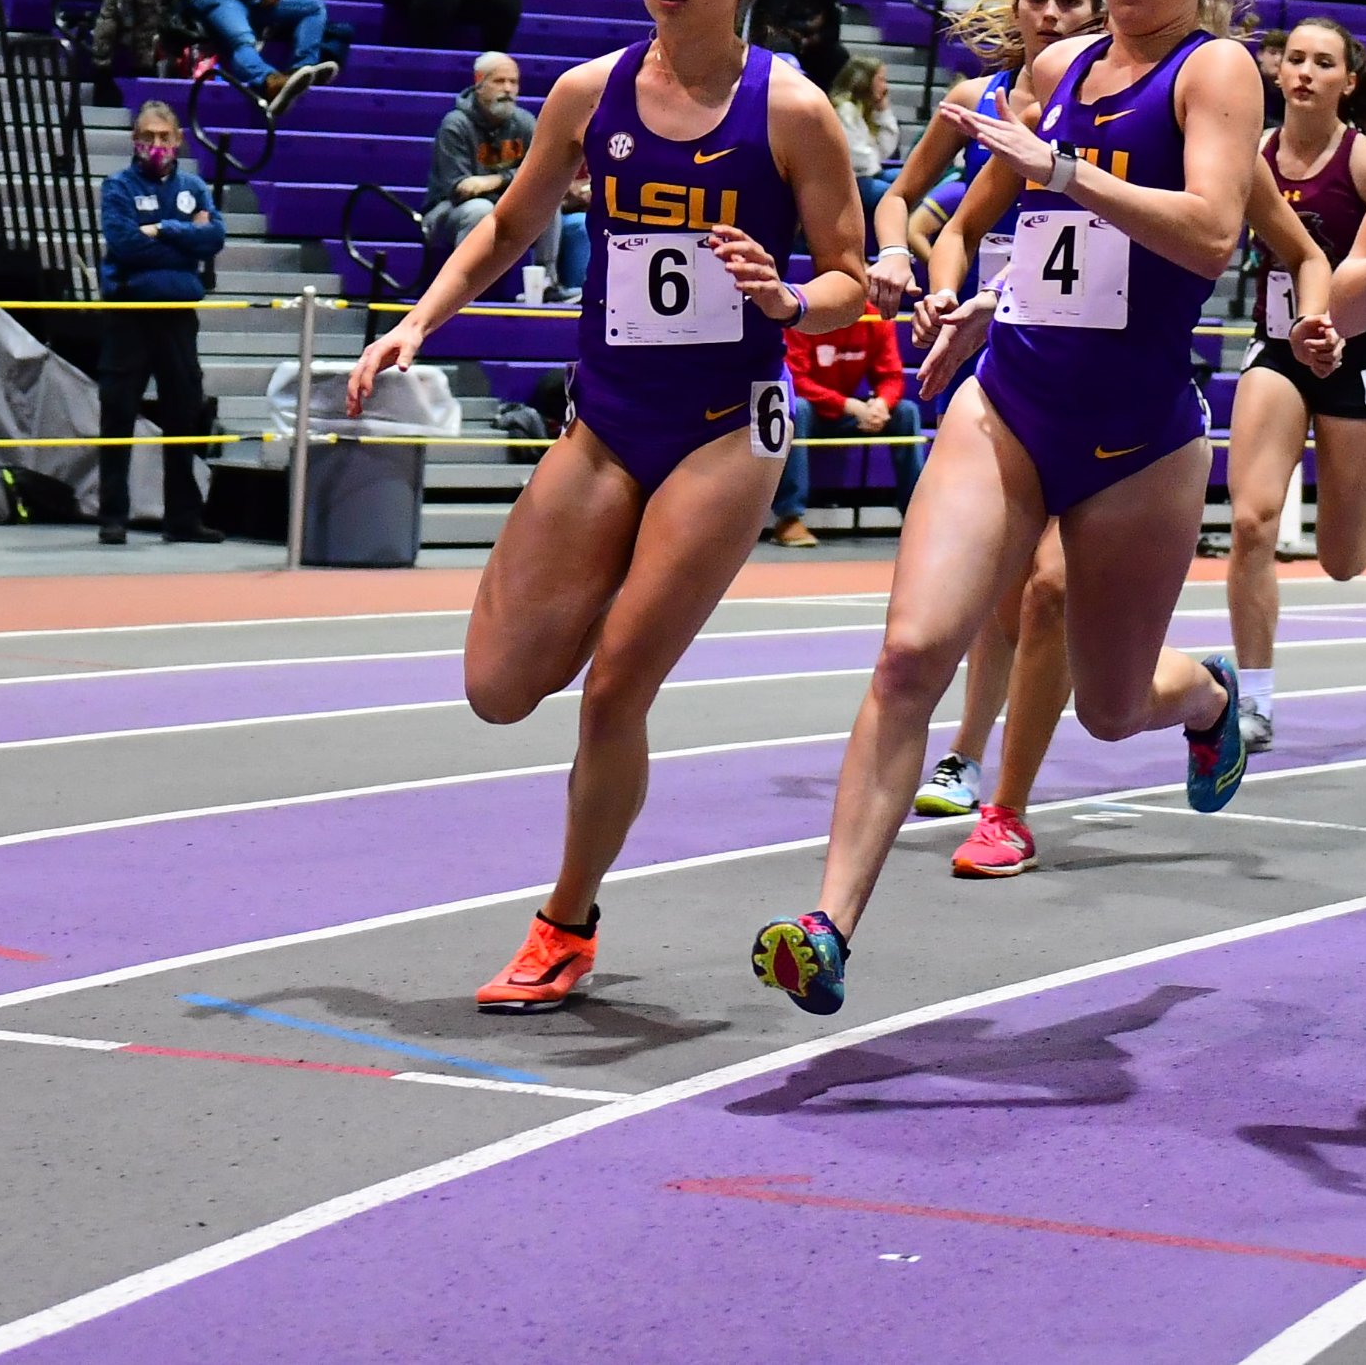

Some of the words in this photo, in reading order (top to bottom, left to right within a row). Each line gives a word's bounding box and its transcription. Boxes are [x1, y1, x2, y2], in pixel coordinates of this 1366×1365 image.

[609, 134, 633, 159] SEC
[604, 175, 738, 230] LSU
[648, 248, 690, 316] 6
[1042, 226, 1079, 295] 4
[757, 385, 785, 452] 6
